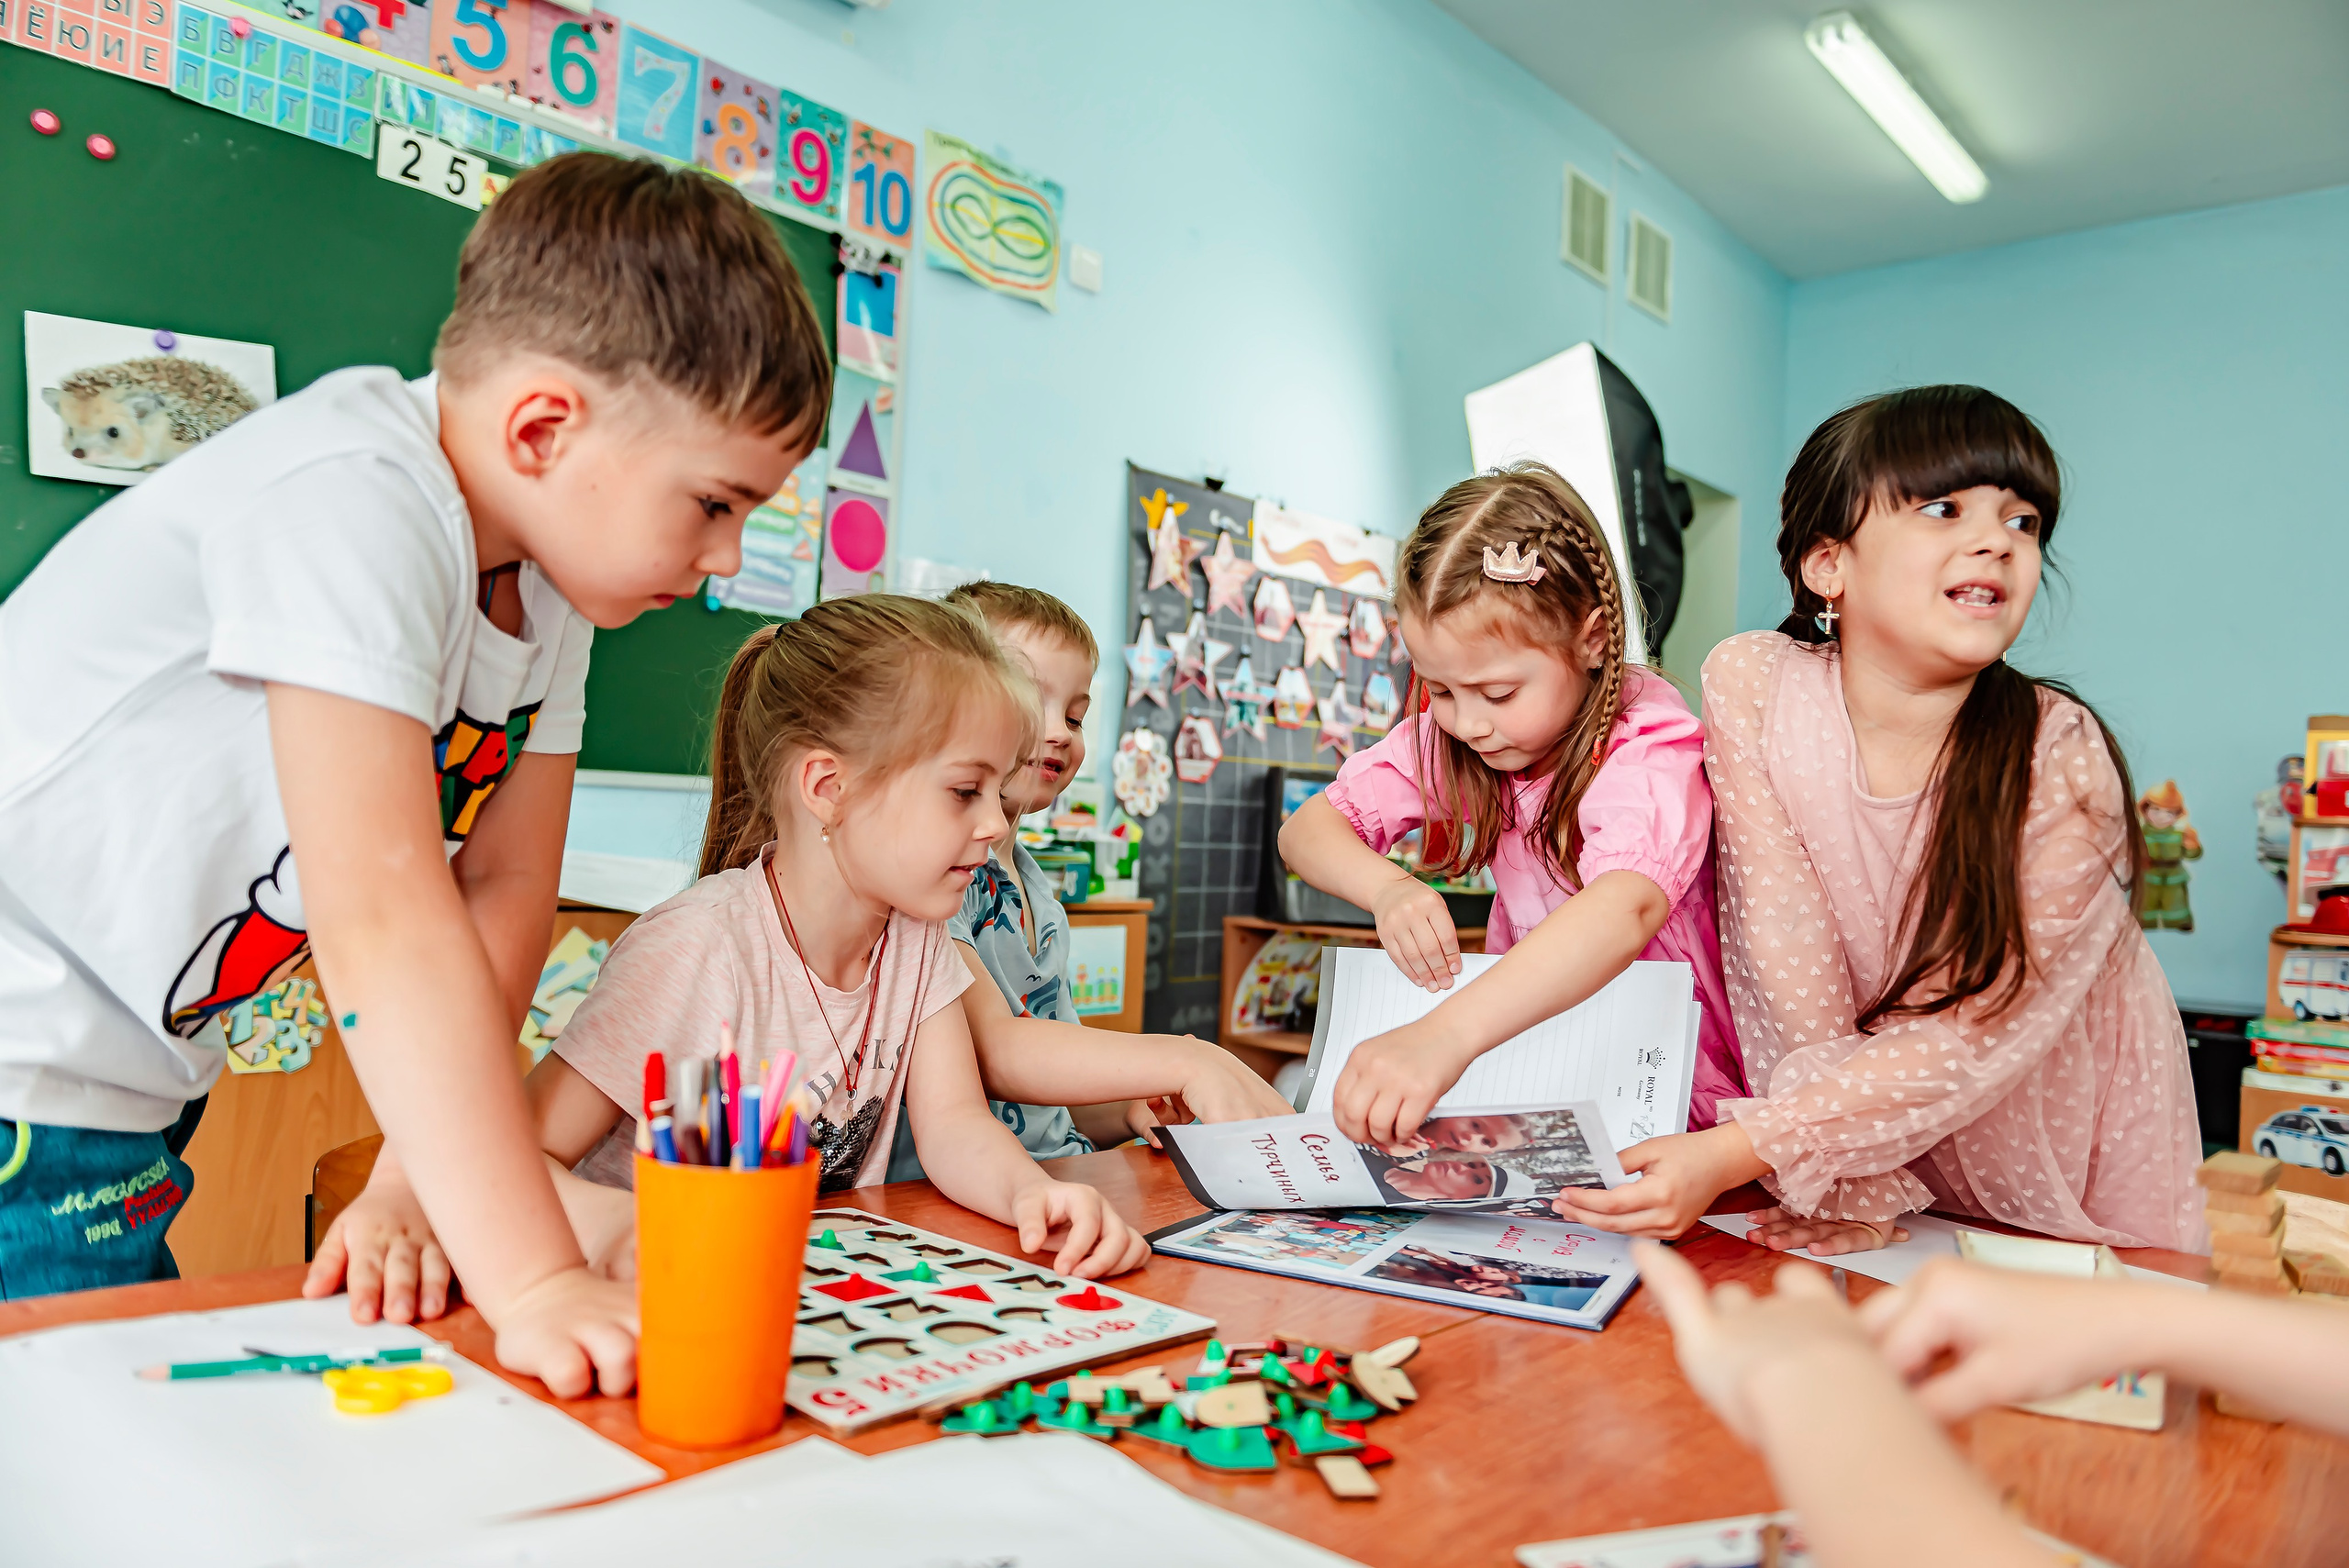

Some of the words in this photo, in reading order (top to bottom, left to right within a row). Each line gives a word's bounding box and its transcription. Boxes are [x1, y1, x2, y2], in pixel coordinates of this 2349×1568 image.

[26, 5, 45, 40] Ё
[57, 18, 91, 51] Ю
[101, 32, 126, 63] И
[142, 45, 161, 72] Е
[145, 1, 165, 26] Э
[184, 16, 201, 42] Б
[217, 29, 236, 54] В
[252, 40, 270, 64] Г
[284, 52, 306, 82] Д
[315, 62, 340, 90] Ж
[181, 61, 201, 90] П
[214, 73, 238, 100] Ф
[248, 84, 268, 113] К
[283, 95, 302, 122] Т
[313, 106, 340, 135] Ш
[349, 117, 367, 145] С
[450, 0, 508, 71] 5
[550, 21, 600, 107] 6
[634, 46, 691, 141] 7
[713, 103, 758, 183] 8
[789, 128, 833, 206] 9
[852, 161, 912, 238] 10
[1644, 1076, 1655, 1106] ROYAL
[1299, 1134, 1340, 1184] Семья
[1552, 1233, 1596, 1256] София
